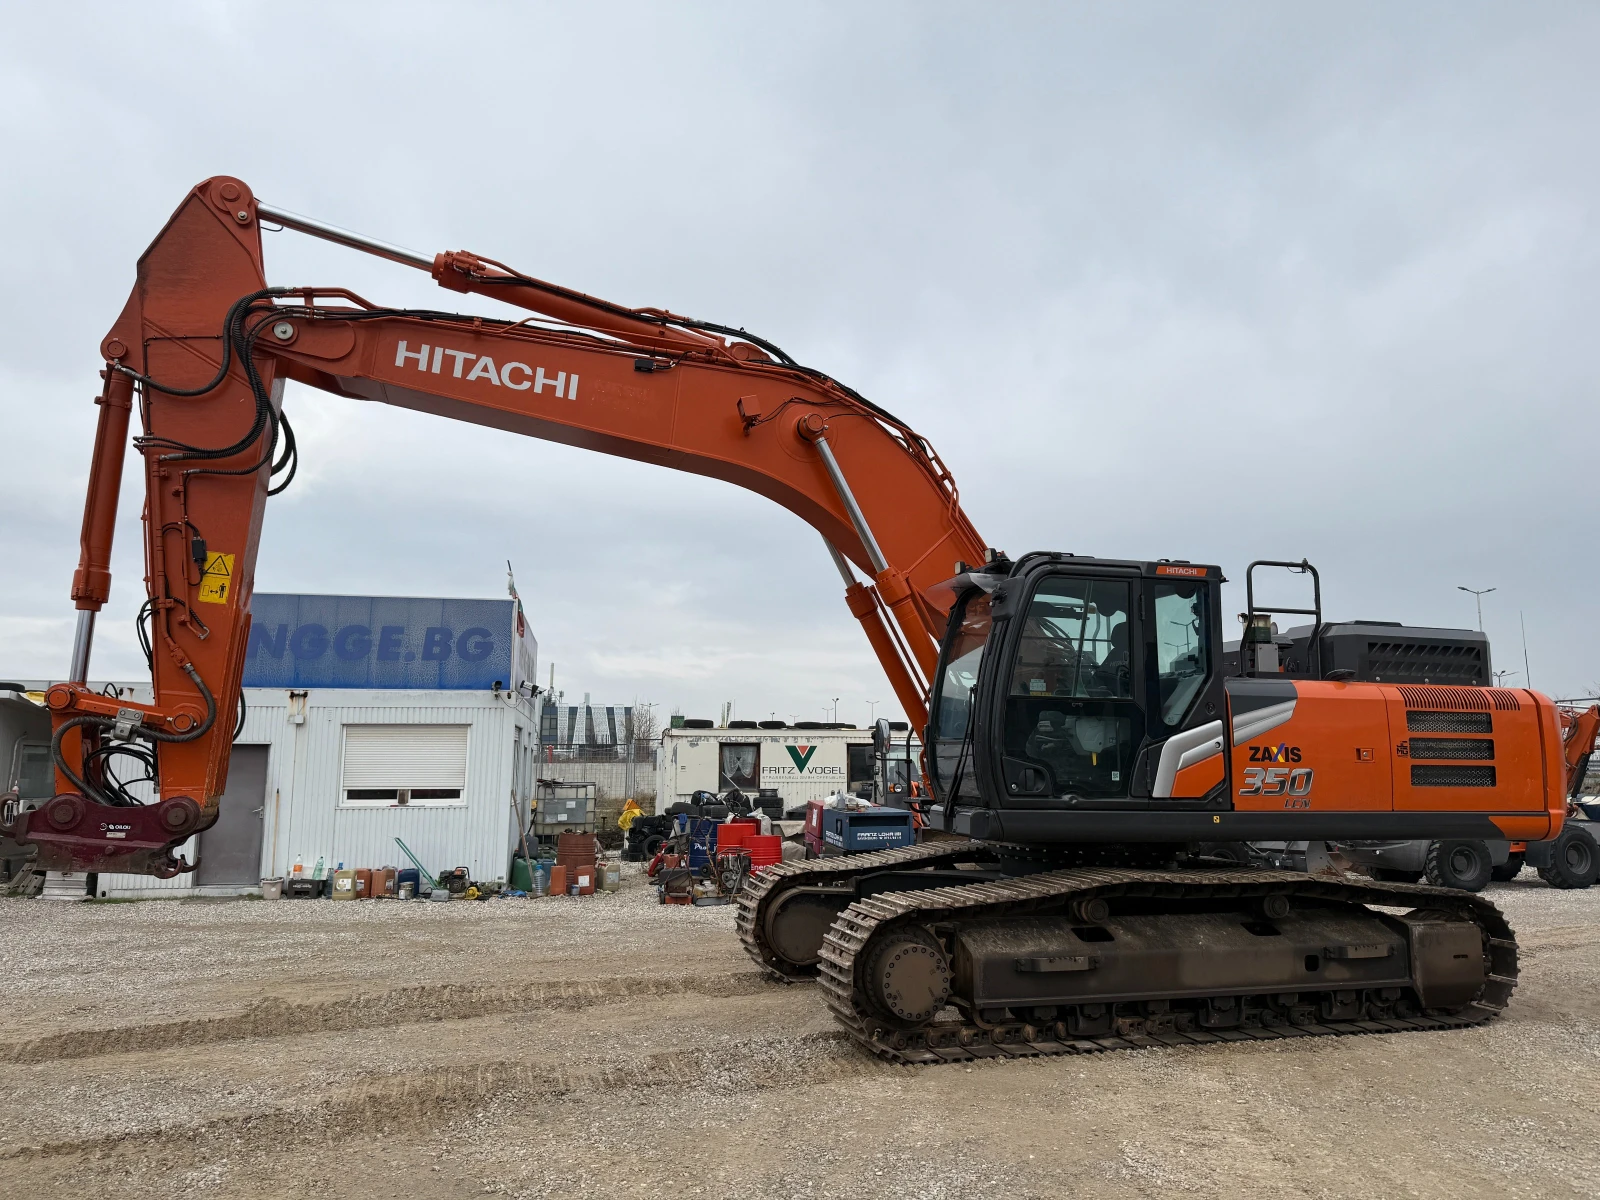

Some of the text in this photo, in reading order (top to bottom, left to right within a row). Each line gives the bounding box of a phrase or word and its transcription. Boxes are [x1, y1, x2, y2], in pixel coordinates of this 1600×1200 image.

[395, 340, 579, 400] HITACHI
[1166, 567, 1197, 575] HITACHI
[1249, 743, 1302, 763] ZAXIS
[762, 766, 845, 775] FRITZ VOGEL
[1239, 767, 1314, 796] 350
